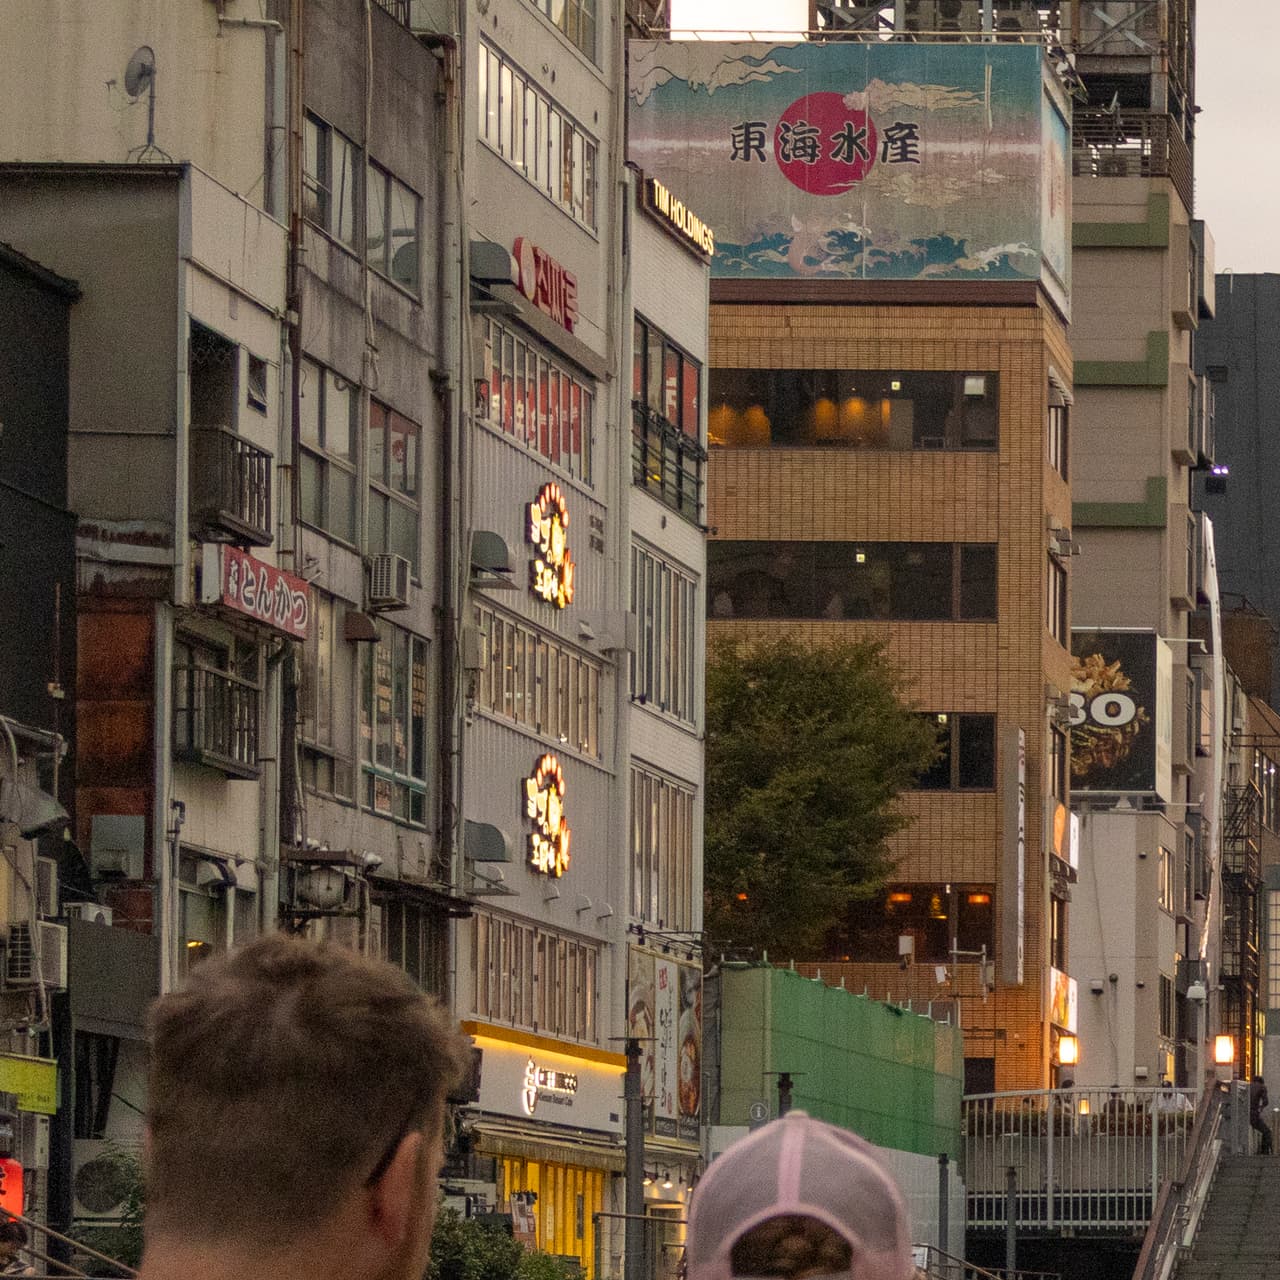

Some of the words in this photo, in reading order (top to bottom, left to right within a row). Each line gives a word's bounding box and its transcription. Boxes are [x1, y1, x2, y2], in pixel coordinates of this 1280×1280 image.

[729, 120, 921, 165] 東海水産
[653, 178, 669, 217] TIM
[670, 194, 714, 256] HOLDINGS
